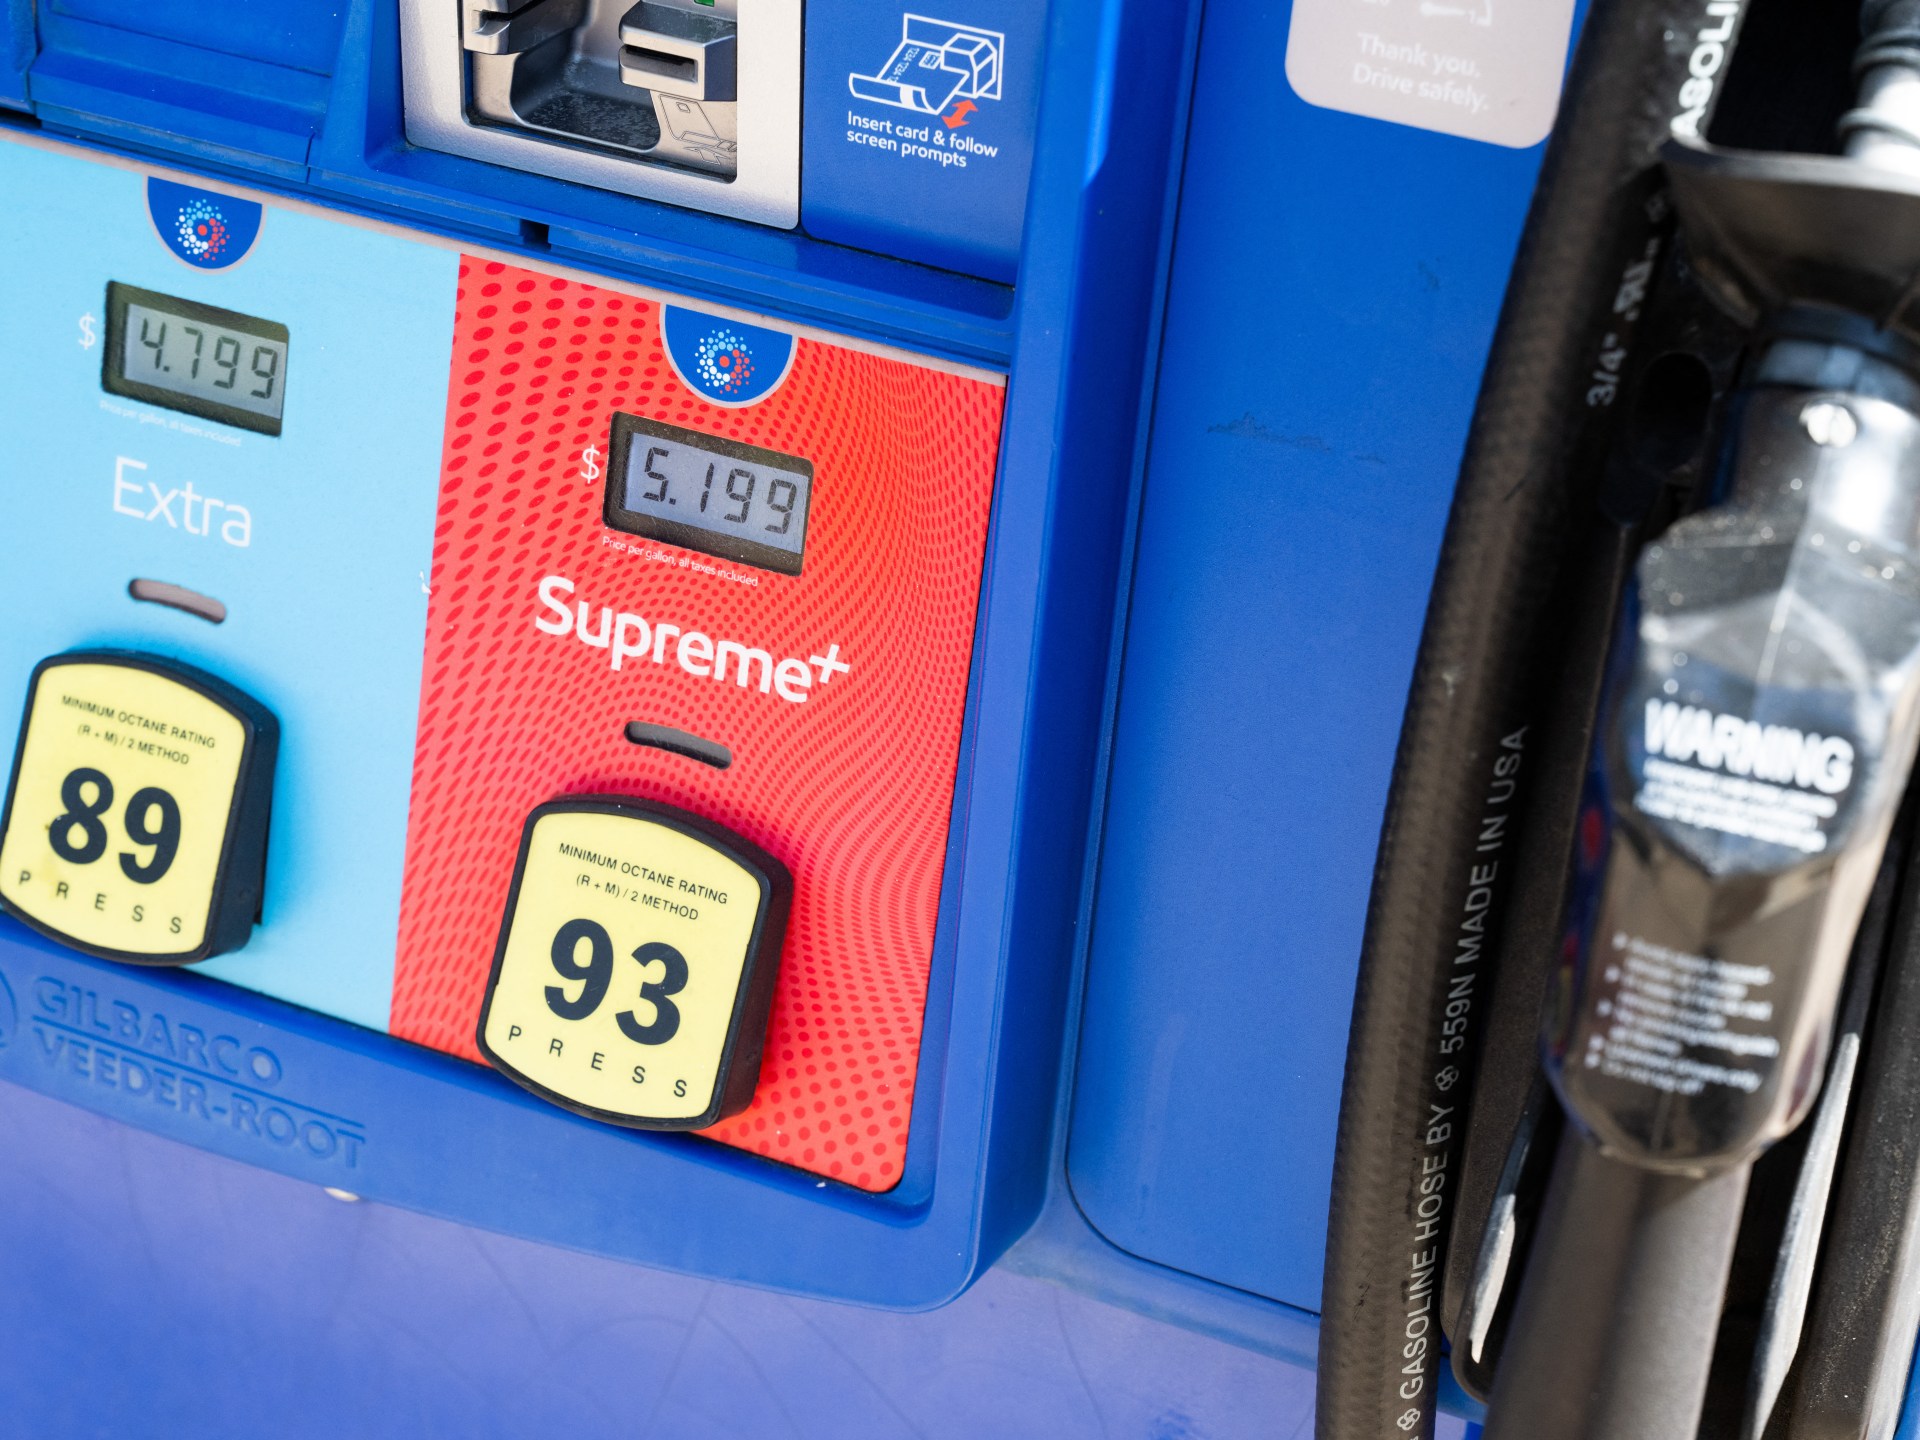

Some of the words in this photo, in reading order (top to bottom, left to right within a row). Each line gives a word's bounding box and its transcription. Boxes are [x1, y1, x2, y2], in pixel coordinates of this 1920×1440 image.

[1353, 63, 1413, 94] Drive
[1417, 80, 1489, 114] safely.
[1358, 31, 1426, 67] Thank
[1433, 52, 1481, 78] you.
[1670, 0, 1739, 137] ASOLI
[847, 110, 892, 134] Insert
[895, 124, 929, 142] card
[933, 130, 945, 146] &
[949, 133, 998, 157] follow
[847, 130, 897, 151] screen
[901, 143, 967, 167] prompts
[78, 311, 96, 350] $
[141, 317, 278, 400] 4.799
[113, 455, 252, 548] Extra
[580, 444, 600, 483] $
[642, 446, 798, 535] 5.199
[602, 535, 627, 551] Price
[628, 545, 644, 556] per
[645, 549, 676, 566] gallon,
[679, 556, 690, 567] all
[691, 560, 716, 575] taxes
[717, 568, 758, 587] included
[535, 575, 850, 703] Supreme+
[62, 694, 115, 719] MINIMUM
[118, 711, 167, 735] OCTANE
[171, 726, 215, 749] RATING
[128, 739, 135, 749] 2
[137, 741, 190, 765] METHOD
[1644, 697, 1854, 794] WARNING
[1487, 725, 1529, 804] USA
[48, 767, 181, 885] 89
[1476, 814, 1508, 851] IN
[558, 842, 618, 870] MINIMUM
[621, 862, 675, 888] OCTANE
[678, 879, 728, 905] RATING
[631, 891, 639, 902] 2
[641, 893, 699, 920] METHOD
[1454, 860, 1498, 965] MADE
[544, 918, 689, 1046] 93
[1440, 973, 1476, 1054] 559N
[36, 975, 283, 1089] GILBARCO
[33, 1027, 366, 1168] VEEDER-ROOT
[1426, 1104, 1454, 1146] BY
[1414, 1151, 1448, 1241] HOSE
[1399, 1246, 1437, 1400] GASOLINE
